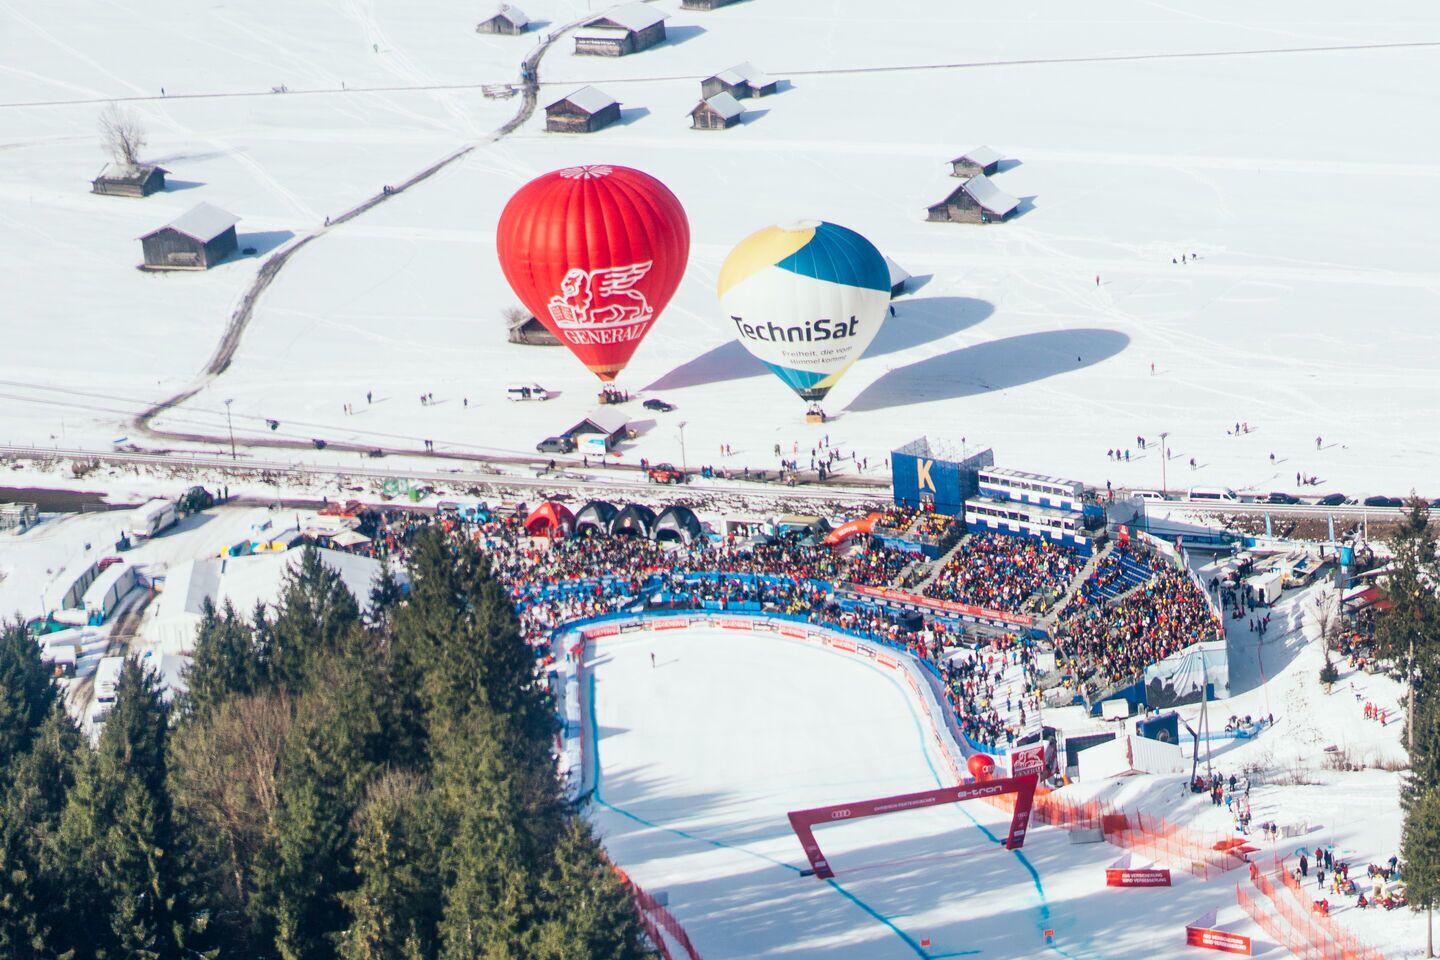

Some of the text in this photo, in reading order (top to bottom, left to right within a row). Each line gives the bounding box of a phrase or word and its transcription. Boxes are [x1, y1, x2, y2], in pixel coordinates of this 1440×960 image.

[564, 322, 648, 345] GENERALI
[731, 315, 859, 342] TechniSat
[917, 458, 937, 493] K
[957, 785, 1003, 798] e-tron
